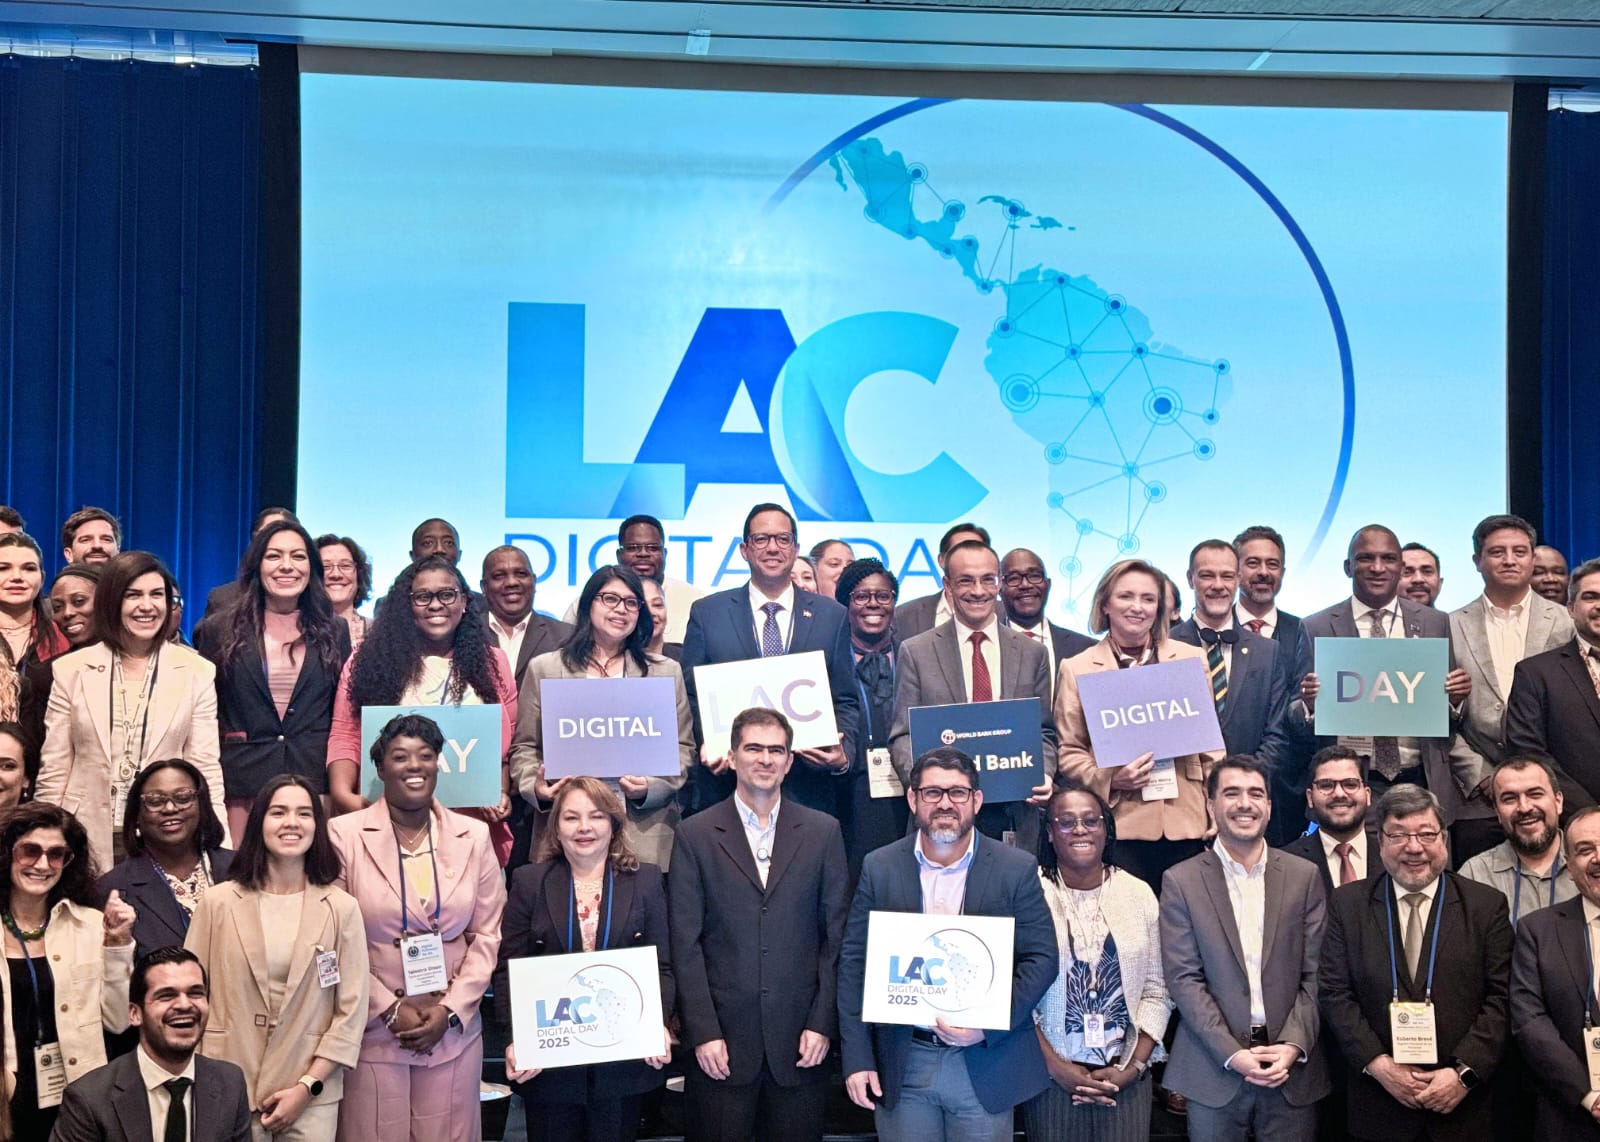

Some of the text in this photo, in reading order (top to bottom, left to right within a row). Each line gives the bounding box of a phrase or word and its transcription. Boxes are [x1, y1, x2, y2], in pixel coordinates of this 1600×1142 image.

[505, 301, 990, 523] LAC
[1337, 670, 1425, 704] DAY
[707, 678, 823, 734] LAC
[1100, 697, 1199, 729] DIGITAL
[558, 716, 662, 739] DIGITAL
[956, 731, 977, 739] WORLD
[993, 728, 1012, 736] GROUP
[986, 751, 1034, 771] Bank
[888, 955, 947, 985] LAC
[887, 985, 948, 995] DIGITAL DAY
[887, 994, 918, 1005] 2025
[535, 996, 597, 1028] LAC
[537, 1023, 599, 1038] DIGITAL DAY
[538, 1036, 570, 1049] 2025
